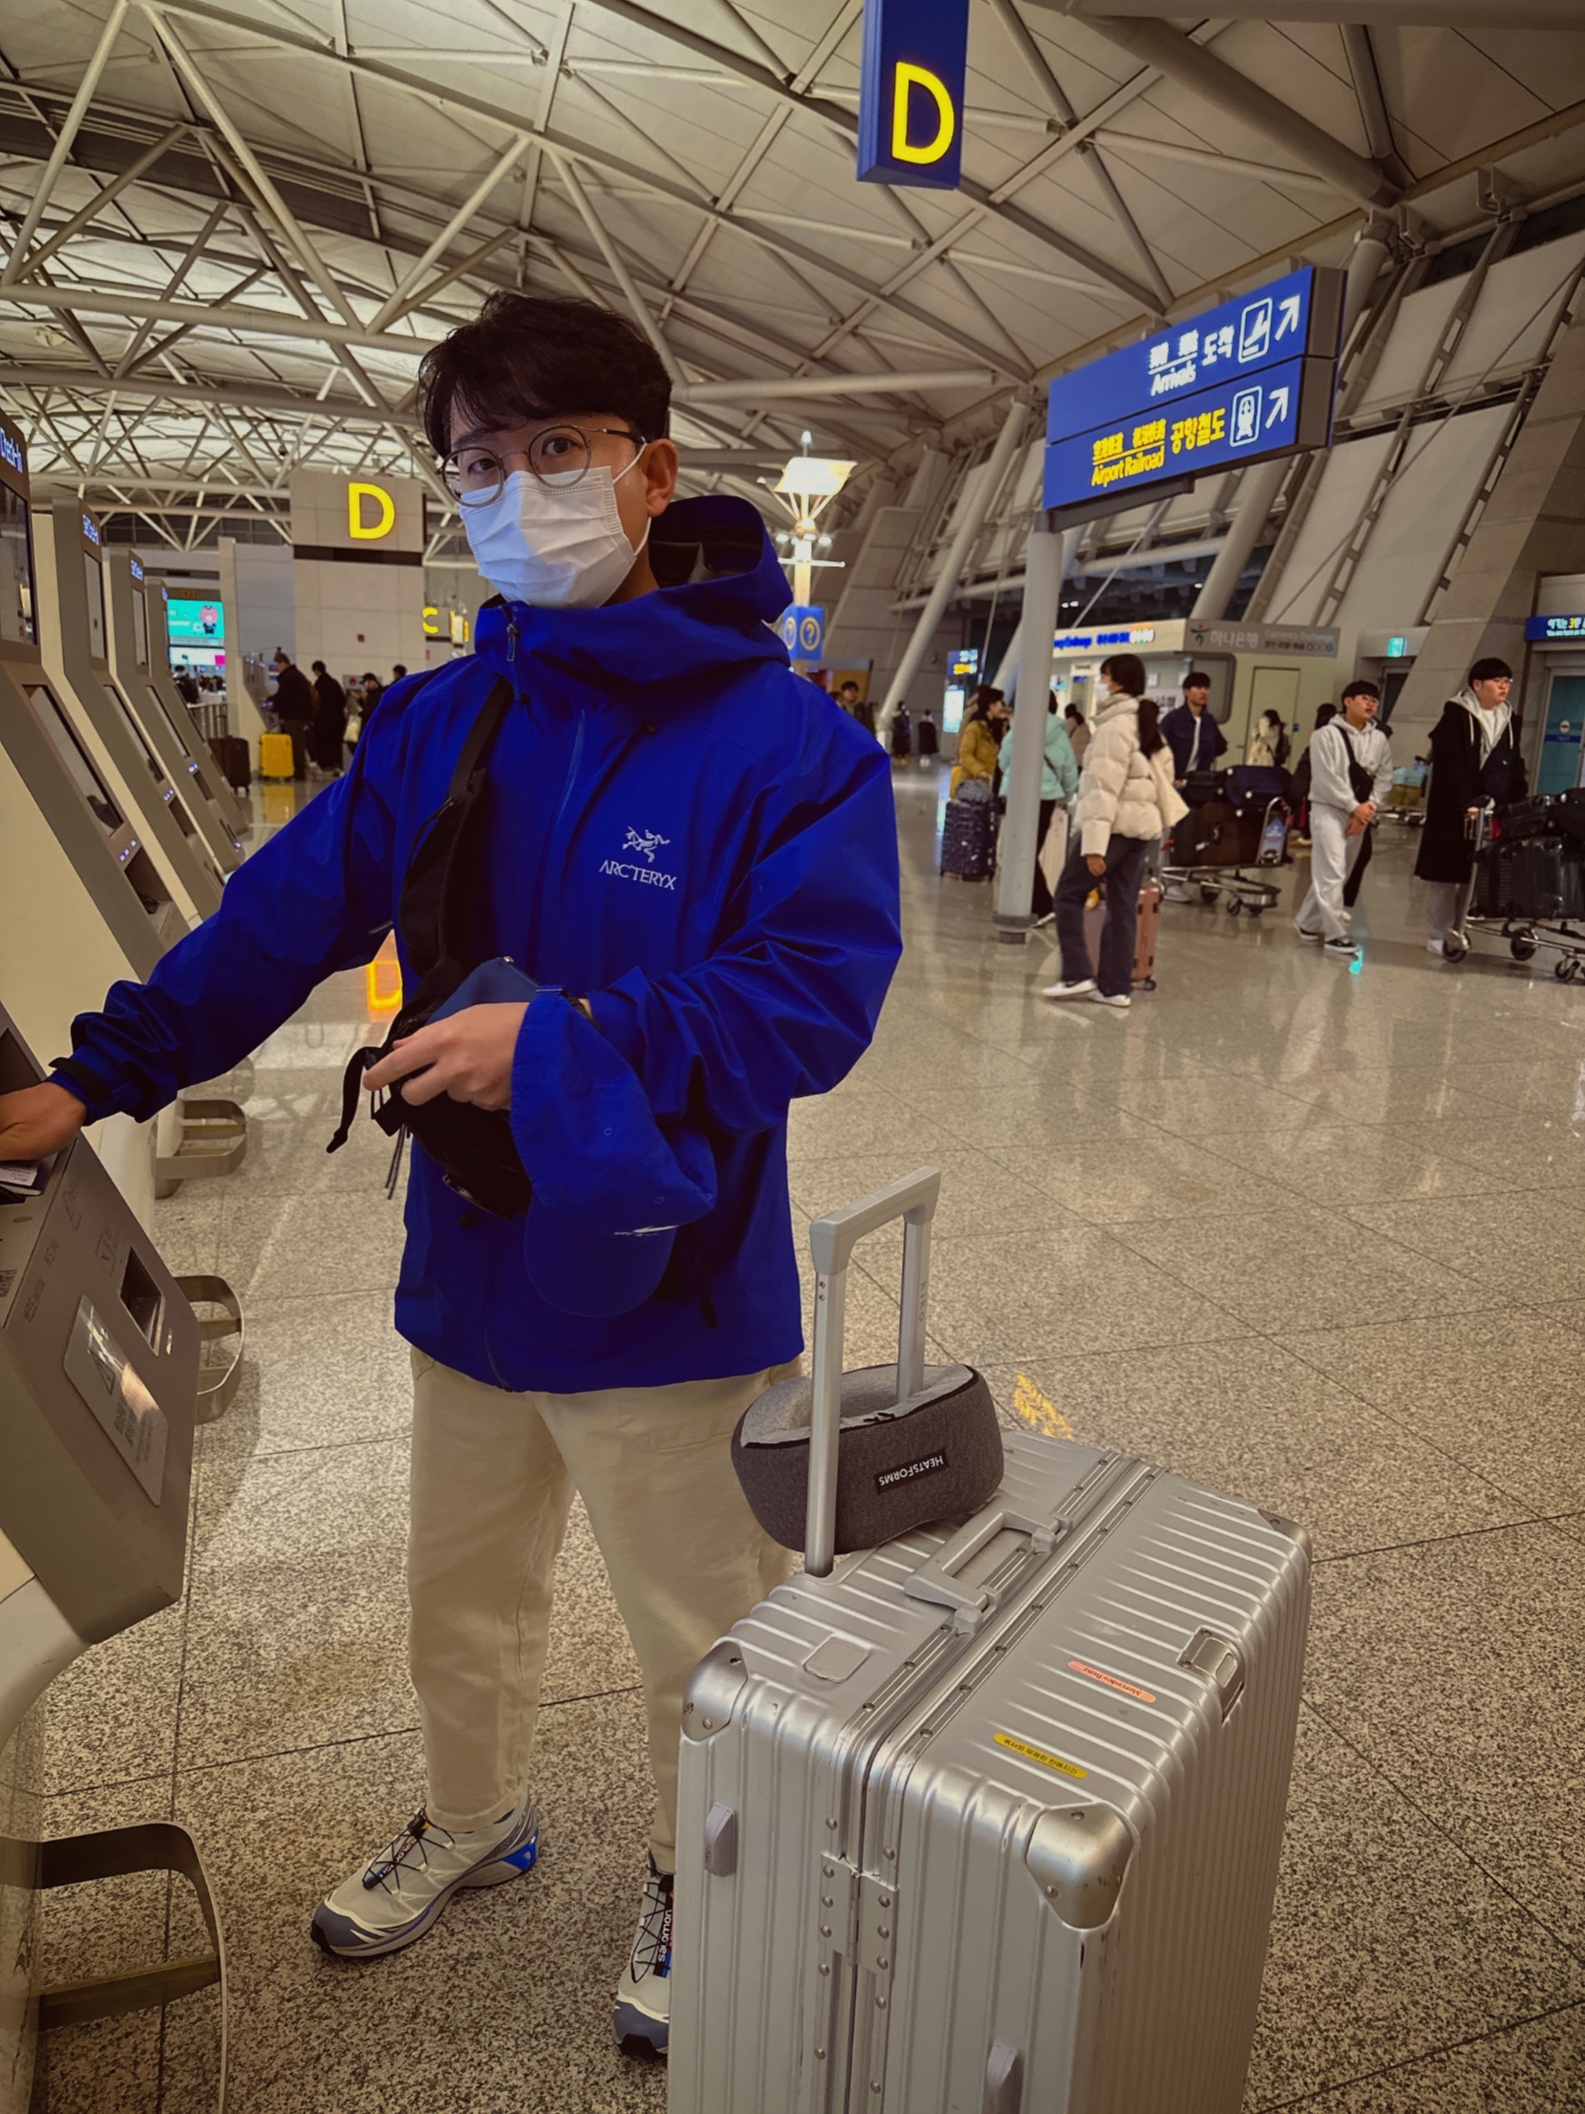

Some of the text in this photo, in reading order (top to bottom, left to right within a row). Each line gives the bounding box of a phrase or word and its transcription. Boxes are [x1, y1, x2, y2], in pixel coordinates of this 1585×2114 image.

[892, 61, 955, 164] D
[1151, 360, 1197, 397] Arrivals
[1170, 407, 1226, 455] 공항철도
[1091, 460, 1124, 488] Airport
[1124, 445, 1165, 478] Railroad
[348, 482, 395, 540] D
[878, 1455, 944, 1487] HEATSFORMS
